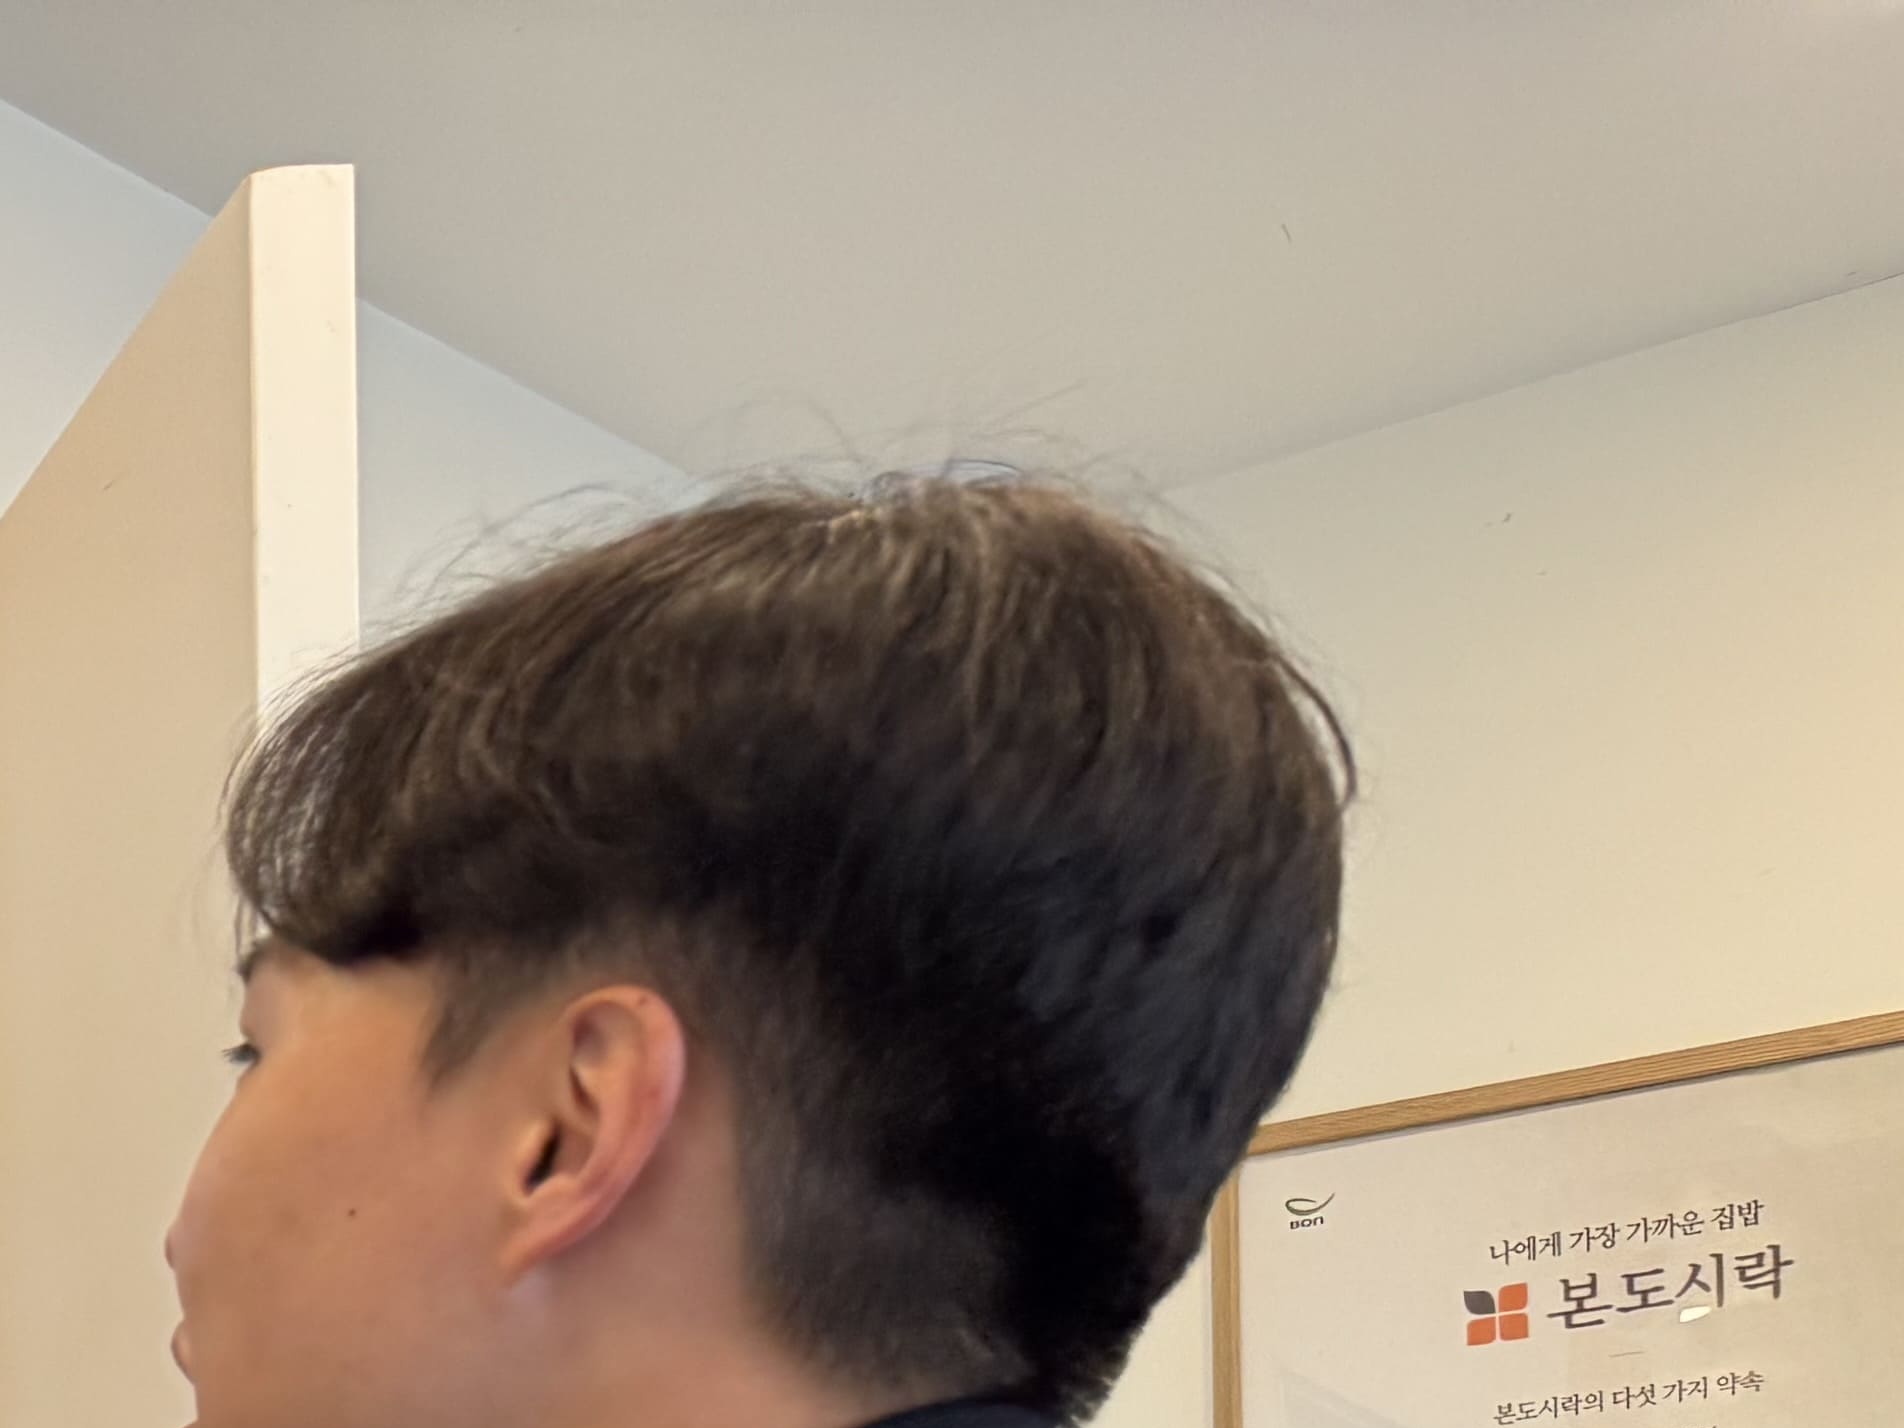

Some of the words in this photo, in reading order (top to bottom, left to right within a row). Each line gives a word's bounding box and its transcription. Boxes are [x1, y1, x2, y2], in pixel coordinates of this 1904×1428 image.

[1489, 1231, 1562, 1266] 나에게
[1569, 1223, 1620, 1252] 가장
[1626, 1210, 1705, 1243] 가까운
[1710, 1199, 1764, 1231] 집밥
[1546, 1244, 1795, 1329] 본도시락
[1493, 1390, 1604, 1426] 본도시락의
[1612, 1383, 1657, 1410] 다섯
[1662, 1376, 1708, 1403] 가지
[1716, 1370, 1765, 1397] 약속
